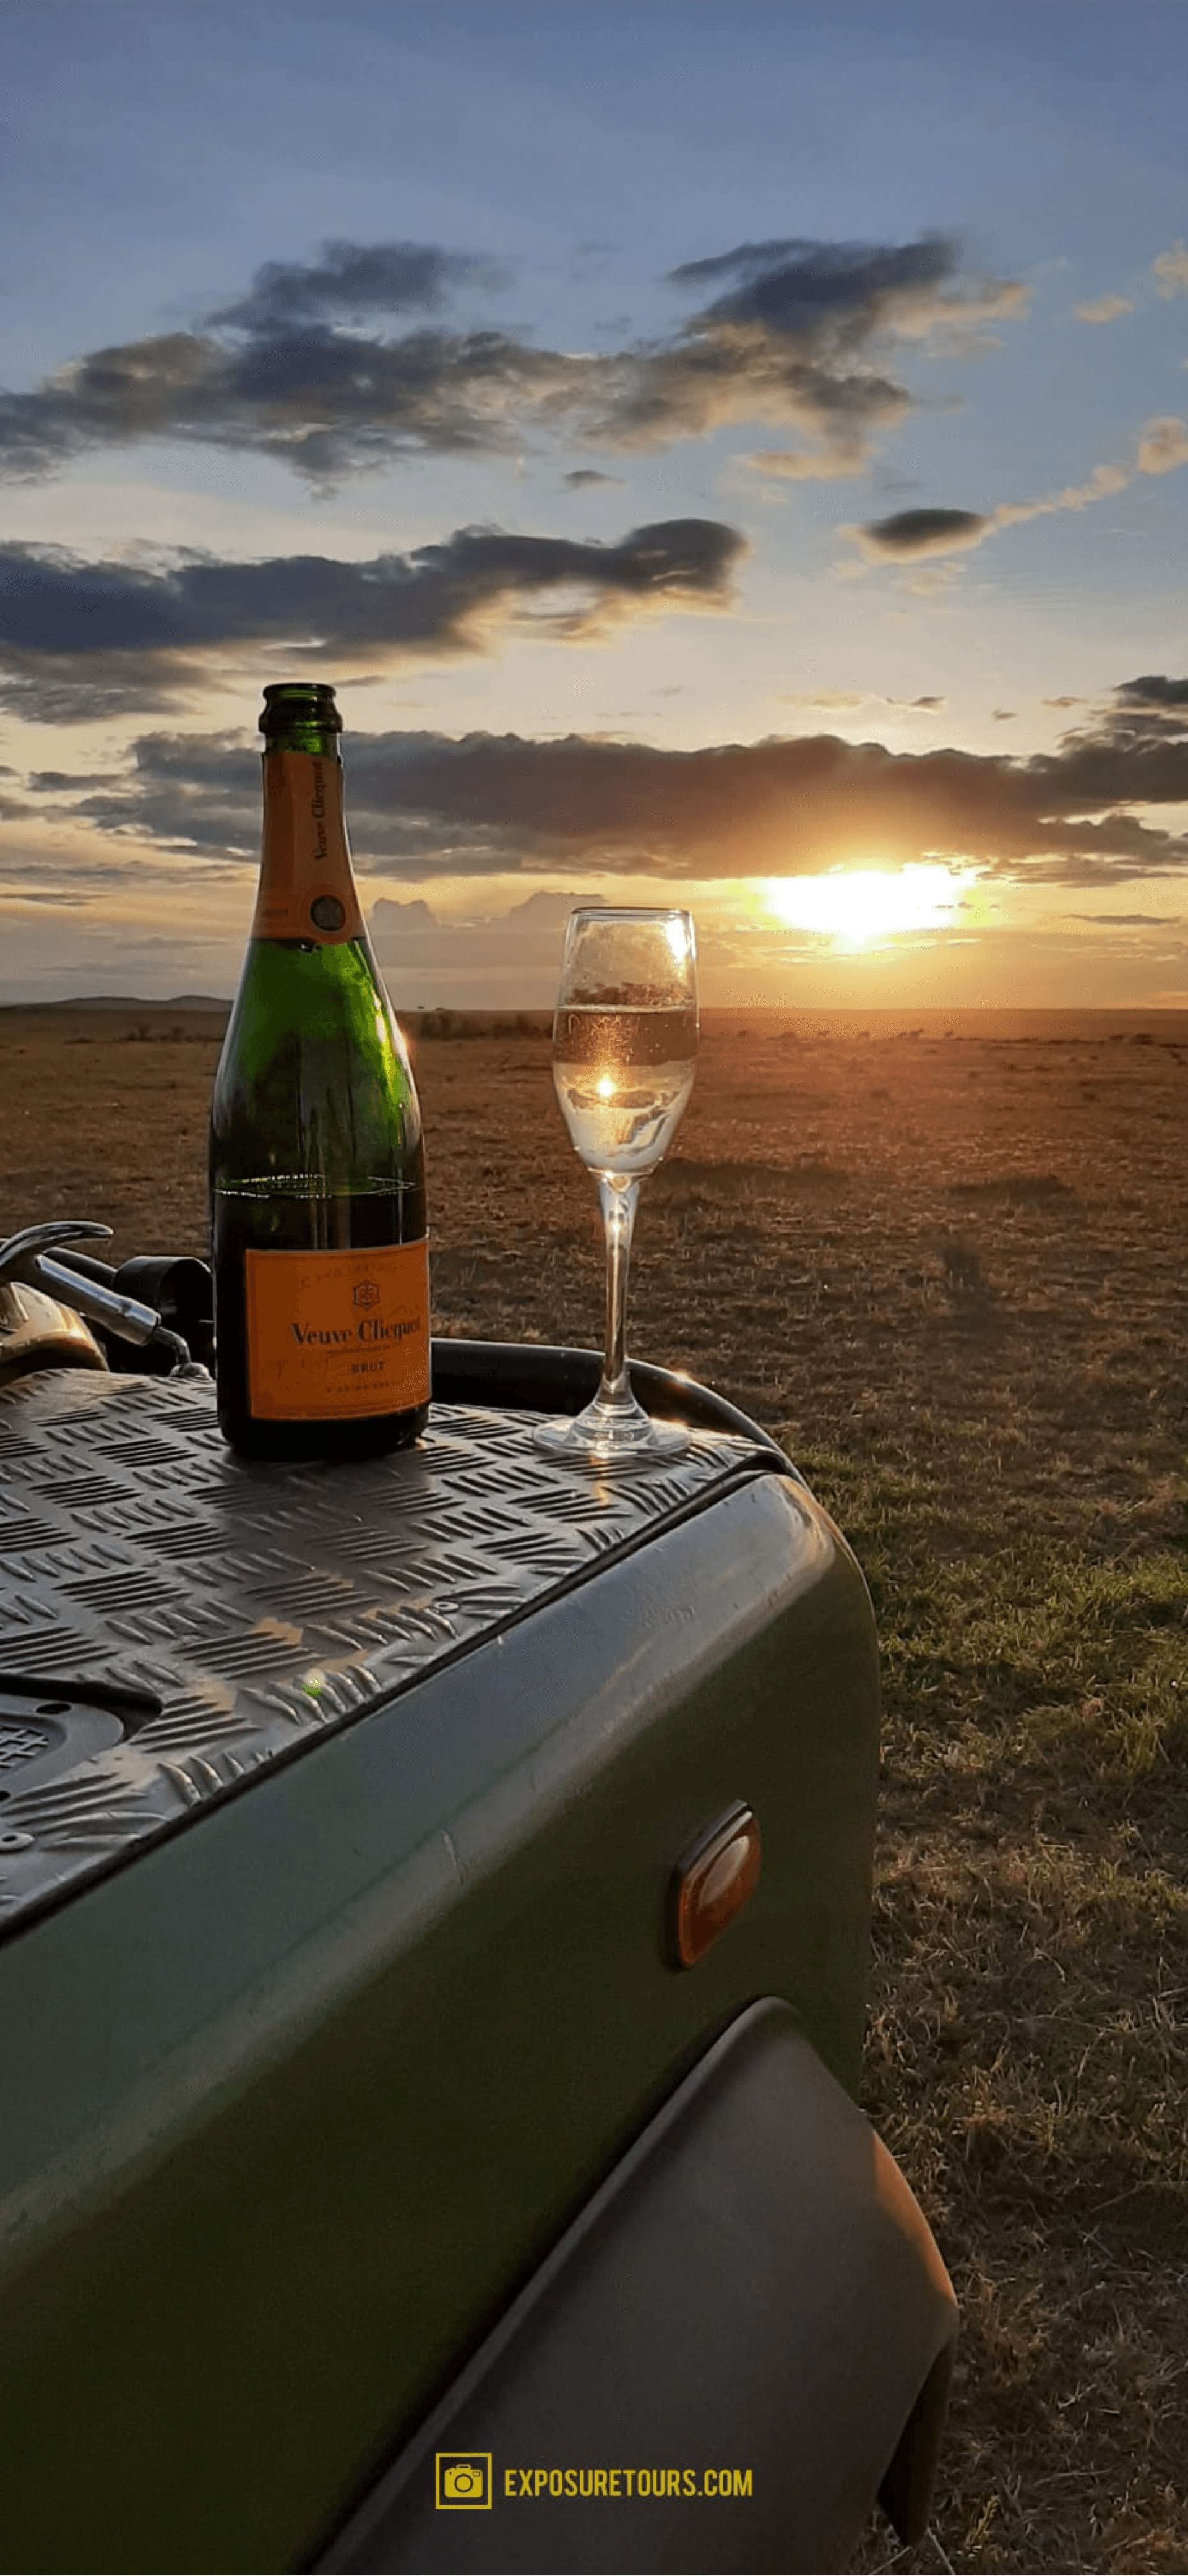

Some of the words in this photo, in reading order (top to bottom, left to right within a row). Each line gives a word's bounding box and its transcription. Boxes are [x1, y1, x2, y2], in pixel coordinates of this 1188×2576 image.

[291, 1323, 353, 1345] Veuve
[356, 1315, 420, 1342] Clicquot
[351, 1361, 386, 1374] BRUT
